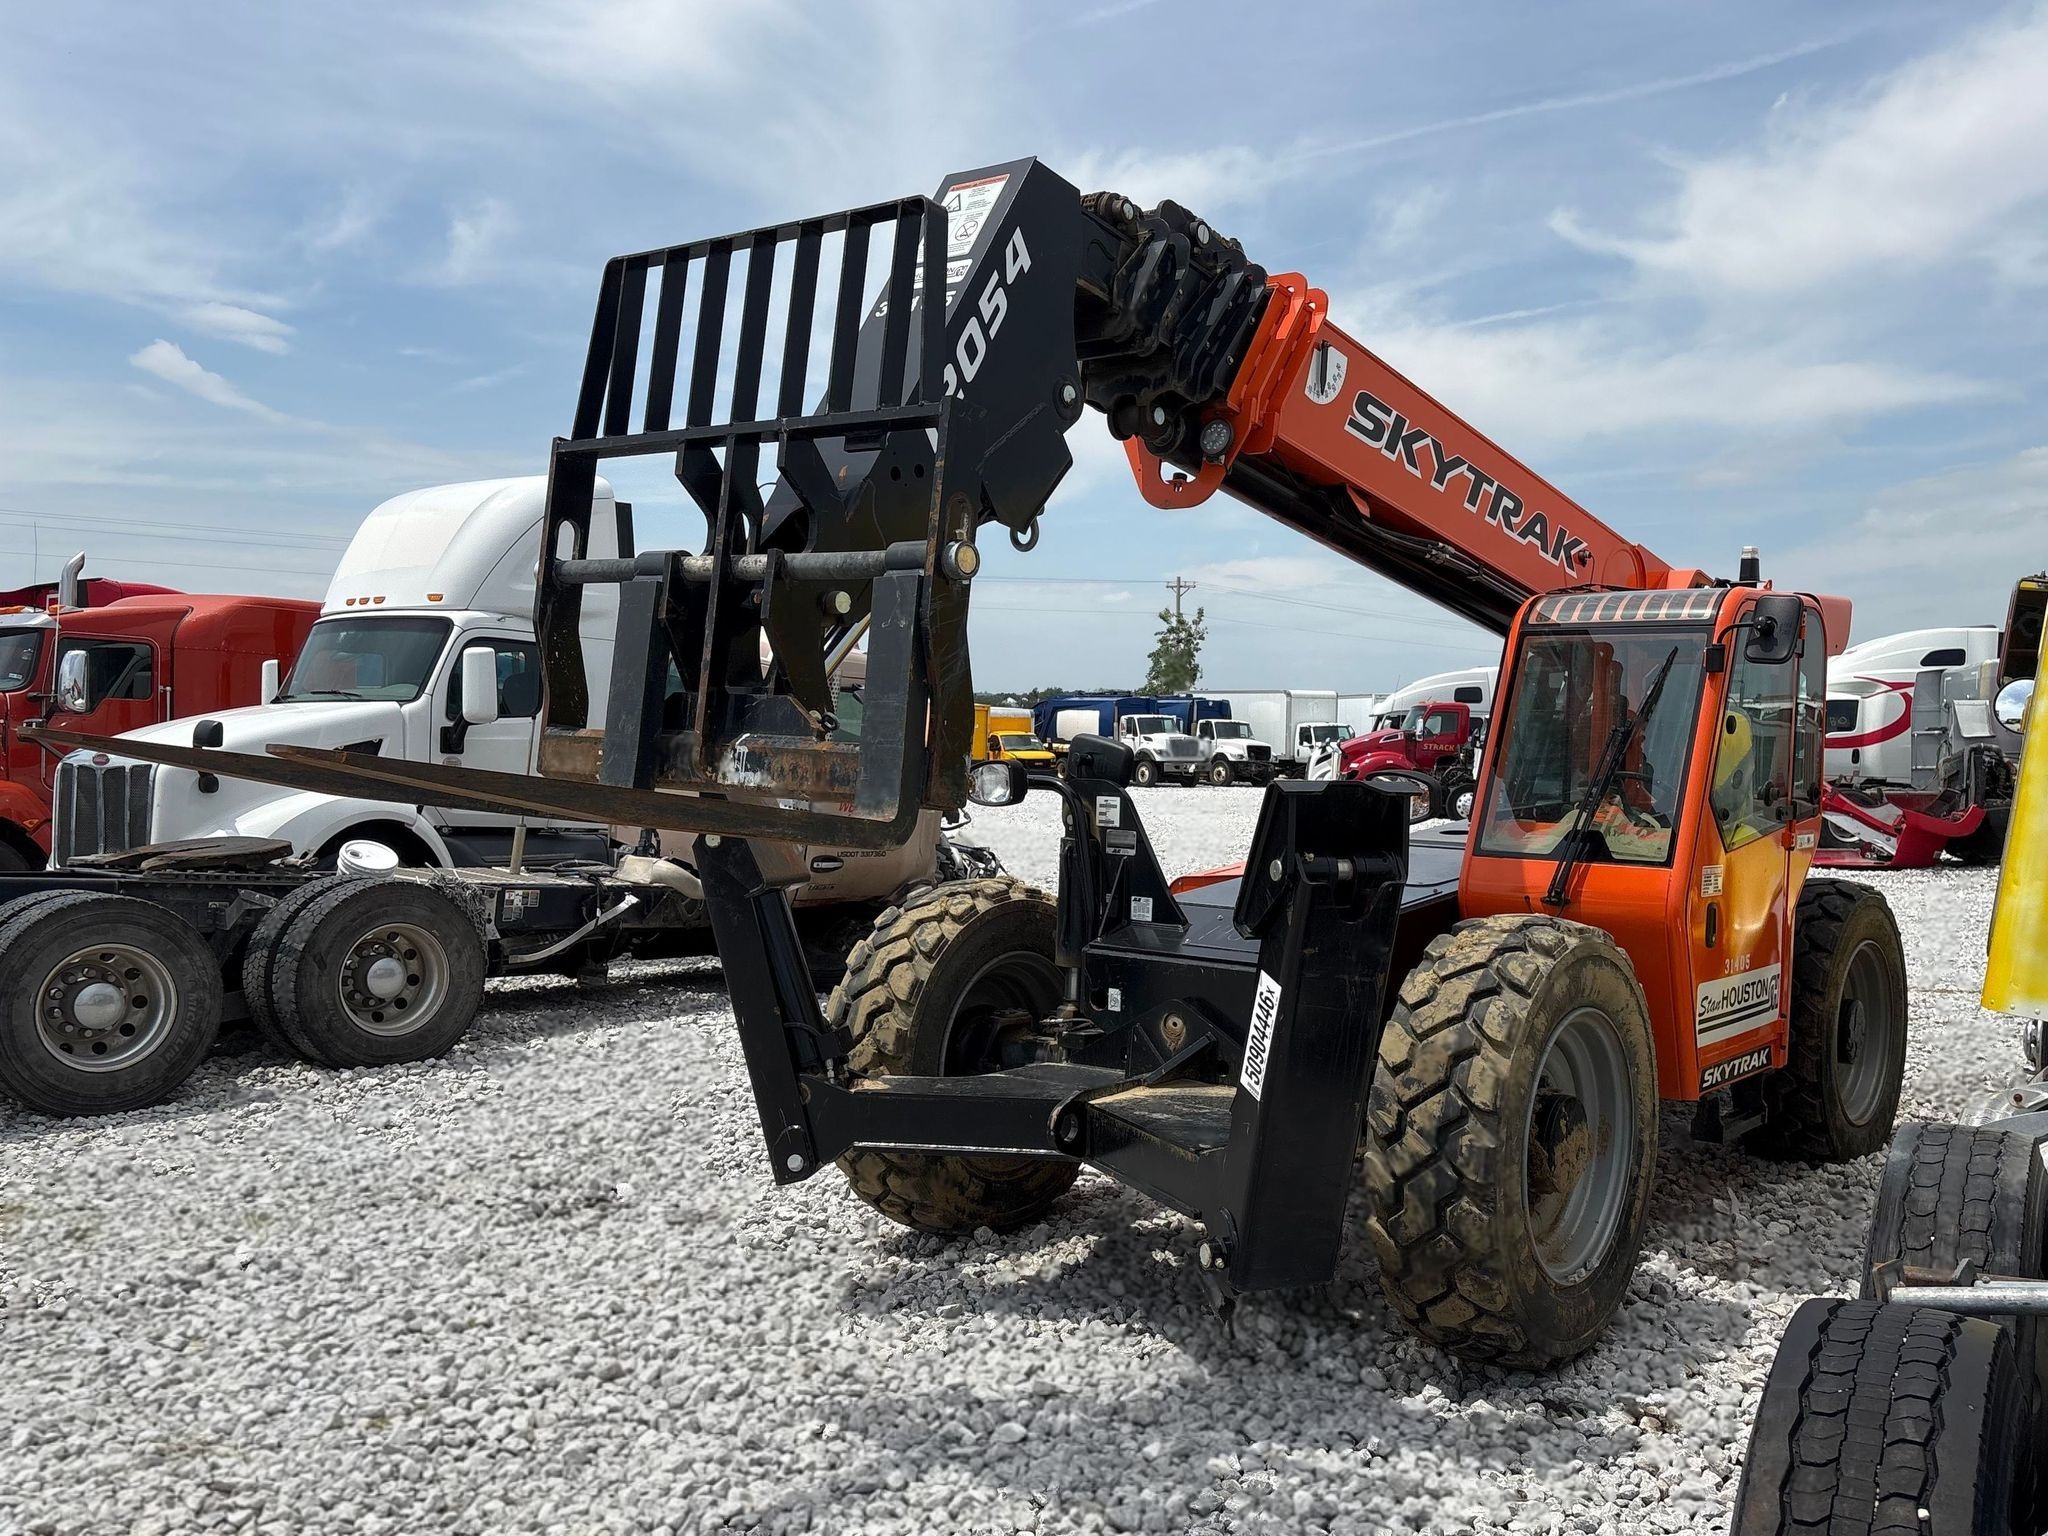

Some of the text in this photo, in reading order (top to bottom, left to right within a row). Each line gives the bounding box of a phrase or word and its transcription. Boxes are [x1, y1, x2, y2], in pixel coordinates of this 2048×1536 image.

[1343, 389, 1588, 579] SKYTRAK
[1423, 743, 1455, 751] STRACK
[1725, 953, 1750, 974] 31405
[1698, 978, 1769, 1017] Stan HOUSTON
[165, 993, 197, 1062] MICHELIN
[1702, 1047, 1769, 1088] SKYTRAK
